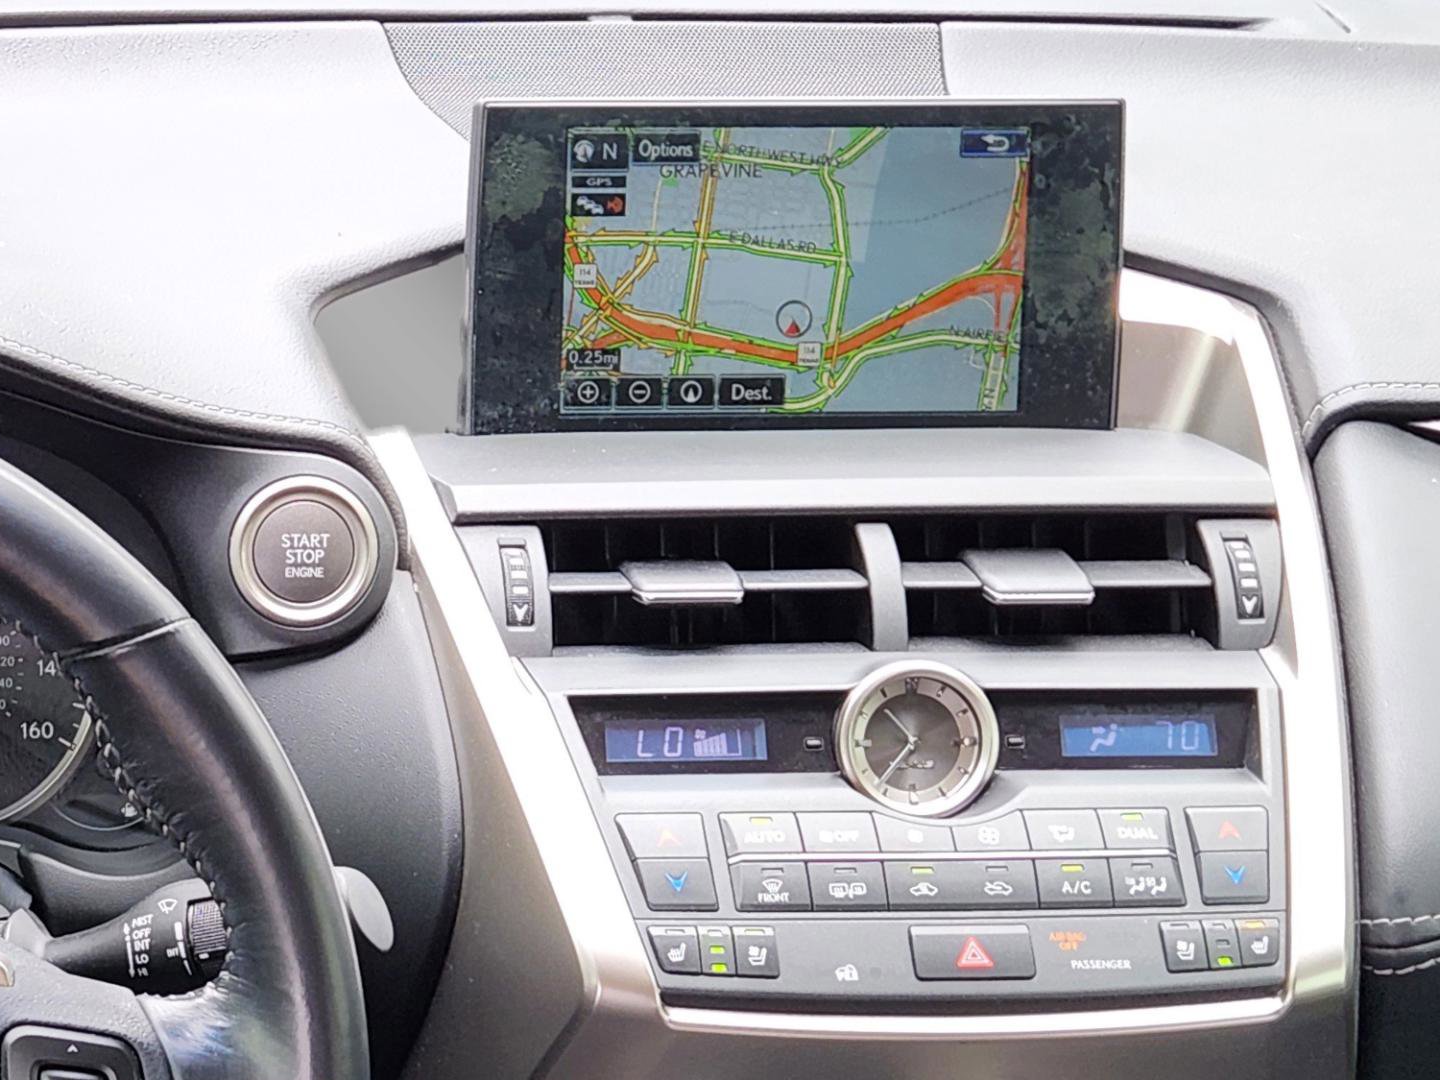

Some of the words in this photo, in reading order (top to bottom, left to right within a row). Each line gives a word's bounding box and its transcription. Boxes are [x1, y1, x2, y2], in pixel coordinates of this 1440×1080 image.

[639, 139, 693, 160] Options
[660, 163, 762, 178] GRAPEVINE
[586, 178, 612, 187] GPS
[742, 232, 794, 250] DALLAS
[798, 241, 817, 253] RD
[732, 383, 772, 400] Dest.
[281, 534, 330, 548] START
[285, 549, 325, 564] STOP
[285, 567, 324, 578] ENGINE
[20, 722, 54, 739] 160
[1156, 720, 1199, 750] 70
[1118, 828, 1158, 840] DUAL
[1062, 882, 1091, 894] A/C
[758, 892, 789, 903] FRONT
[132, 927, 152, 940] OFF
[135, 953, 149, 965] LO
[1071, 960, 1131, 970] PASSENGER
